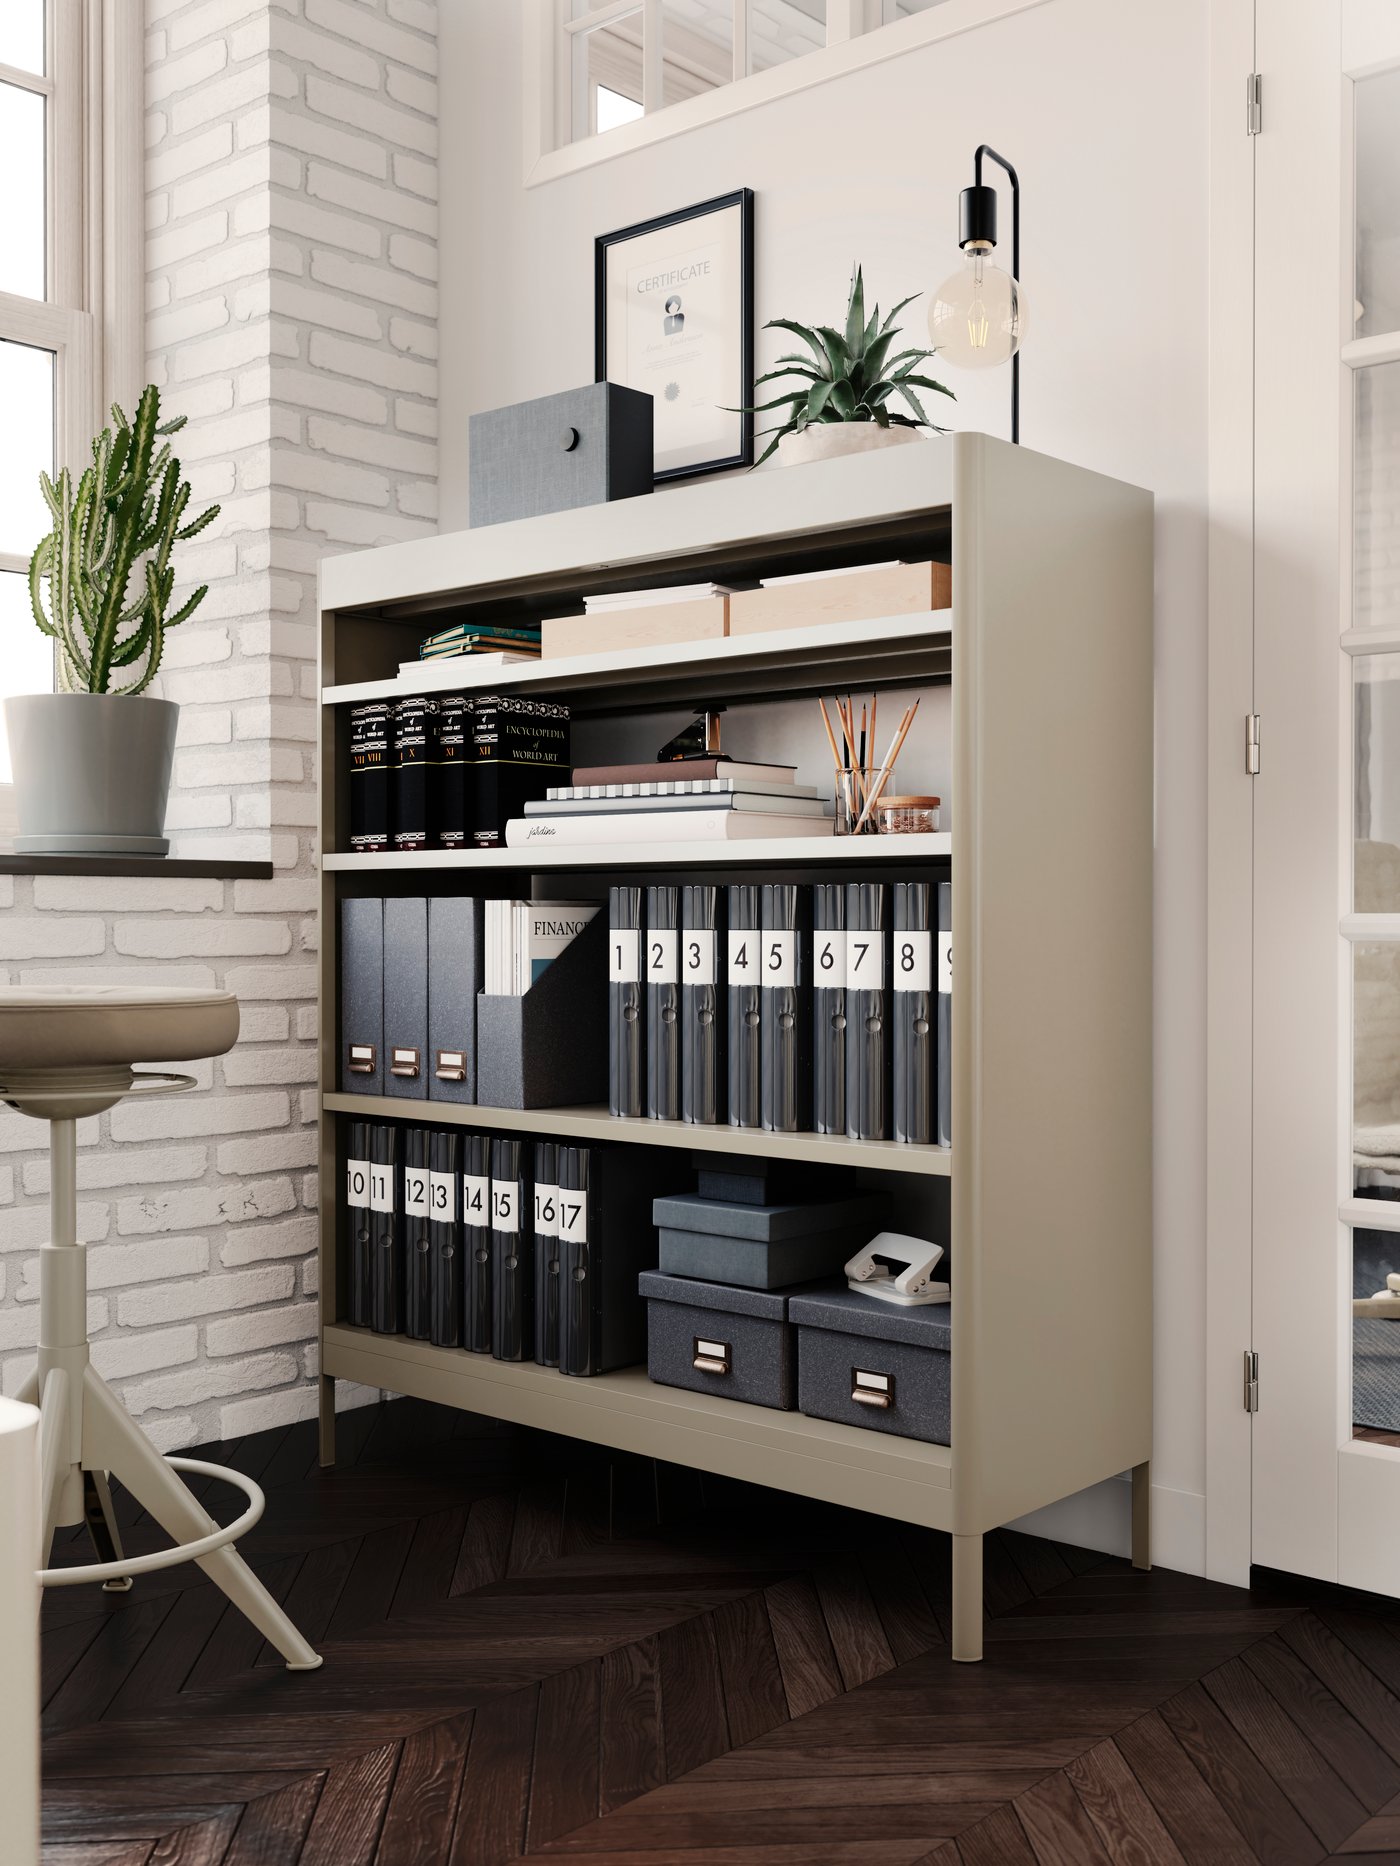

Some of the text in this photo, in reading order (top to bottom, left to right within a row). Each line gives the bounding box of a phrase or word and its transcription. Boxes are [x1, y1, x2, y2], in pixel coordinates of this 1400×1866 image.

[637, 260, 711, 294] CERTIFICATE
[506, 725, 564, 739] ENCYCLOPEDIA
[533, 740, 540, 750] of
[367, 752, 381, 762] VIII
[409, 748, 415, 758] X
[446, 747, 454, 756] XI
[479, 746, 490, 755] XII
[512, 750, 559, 761] WORLD ART
[616, 945, 621, 970] 1
[652, 943, 663, 969] 2
[689, 942, 701, 969] 3
[734, 942, 748, 968] 4
[768, 944, 782, 971] 5
[820, 942, 834, 970] 6
[854, 944, 870, 971] 7
[901, 943, 914, 972] 8
[348, 1170, 364, 1194] 10
[372, 1175, 384, 1200] 11
[406, 1179, 425, 1203] 12
[430, 1183, 447, 1209] 13
[464, 1186, 482, 1212] 14
[493, 1192, 511, 1218] 15
[535, 1195, 555, 1222] 16
[560, 1203, 582, 1230] 17
